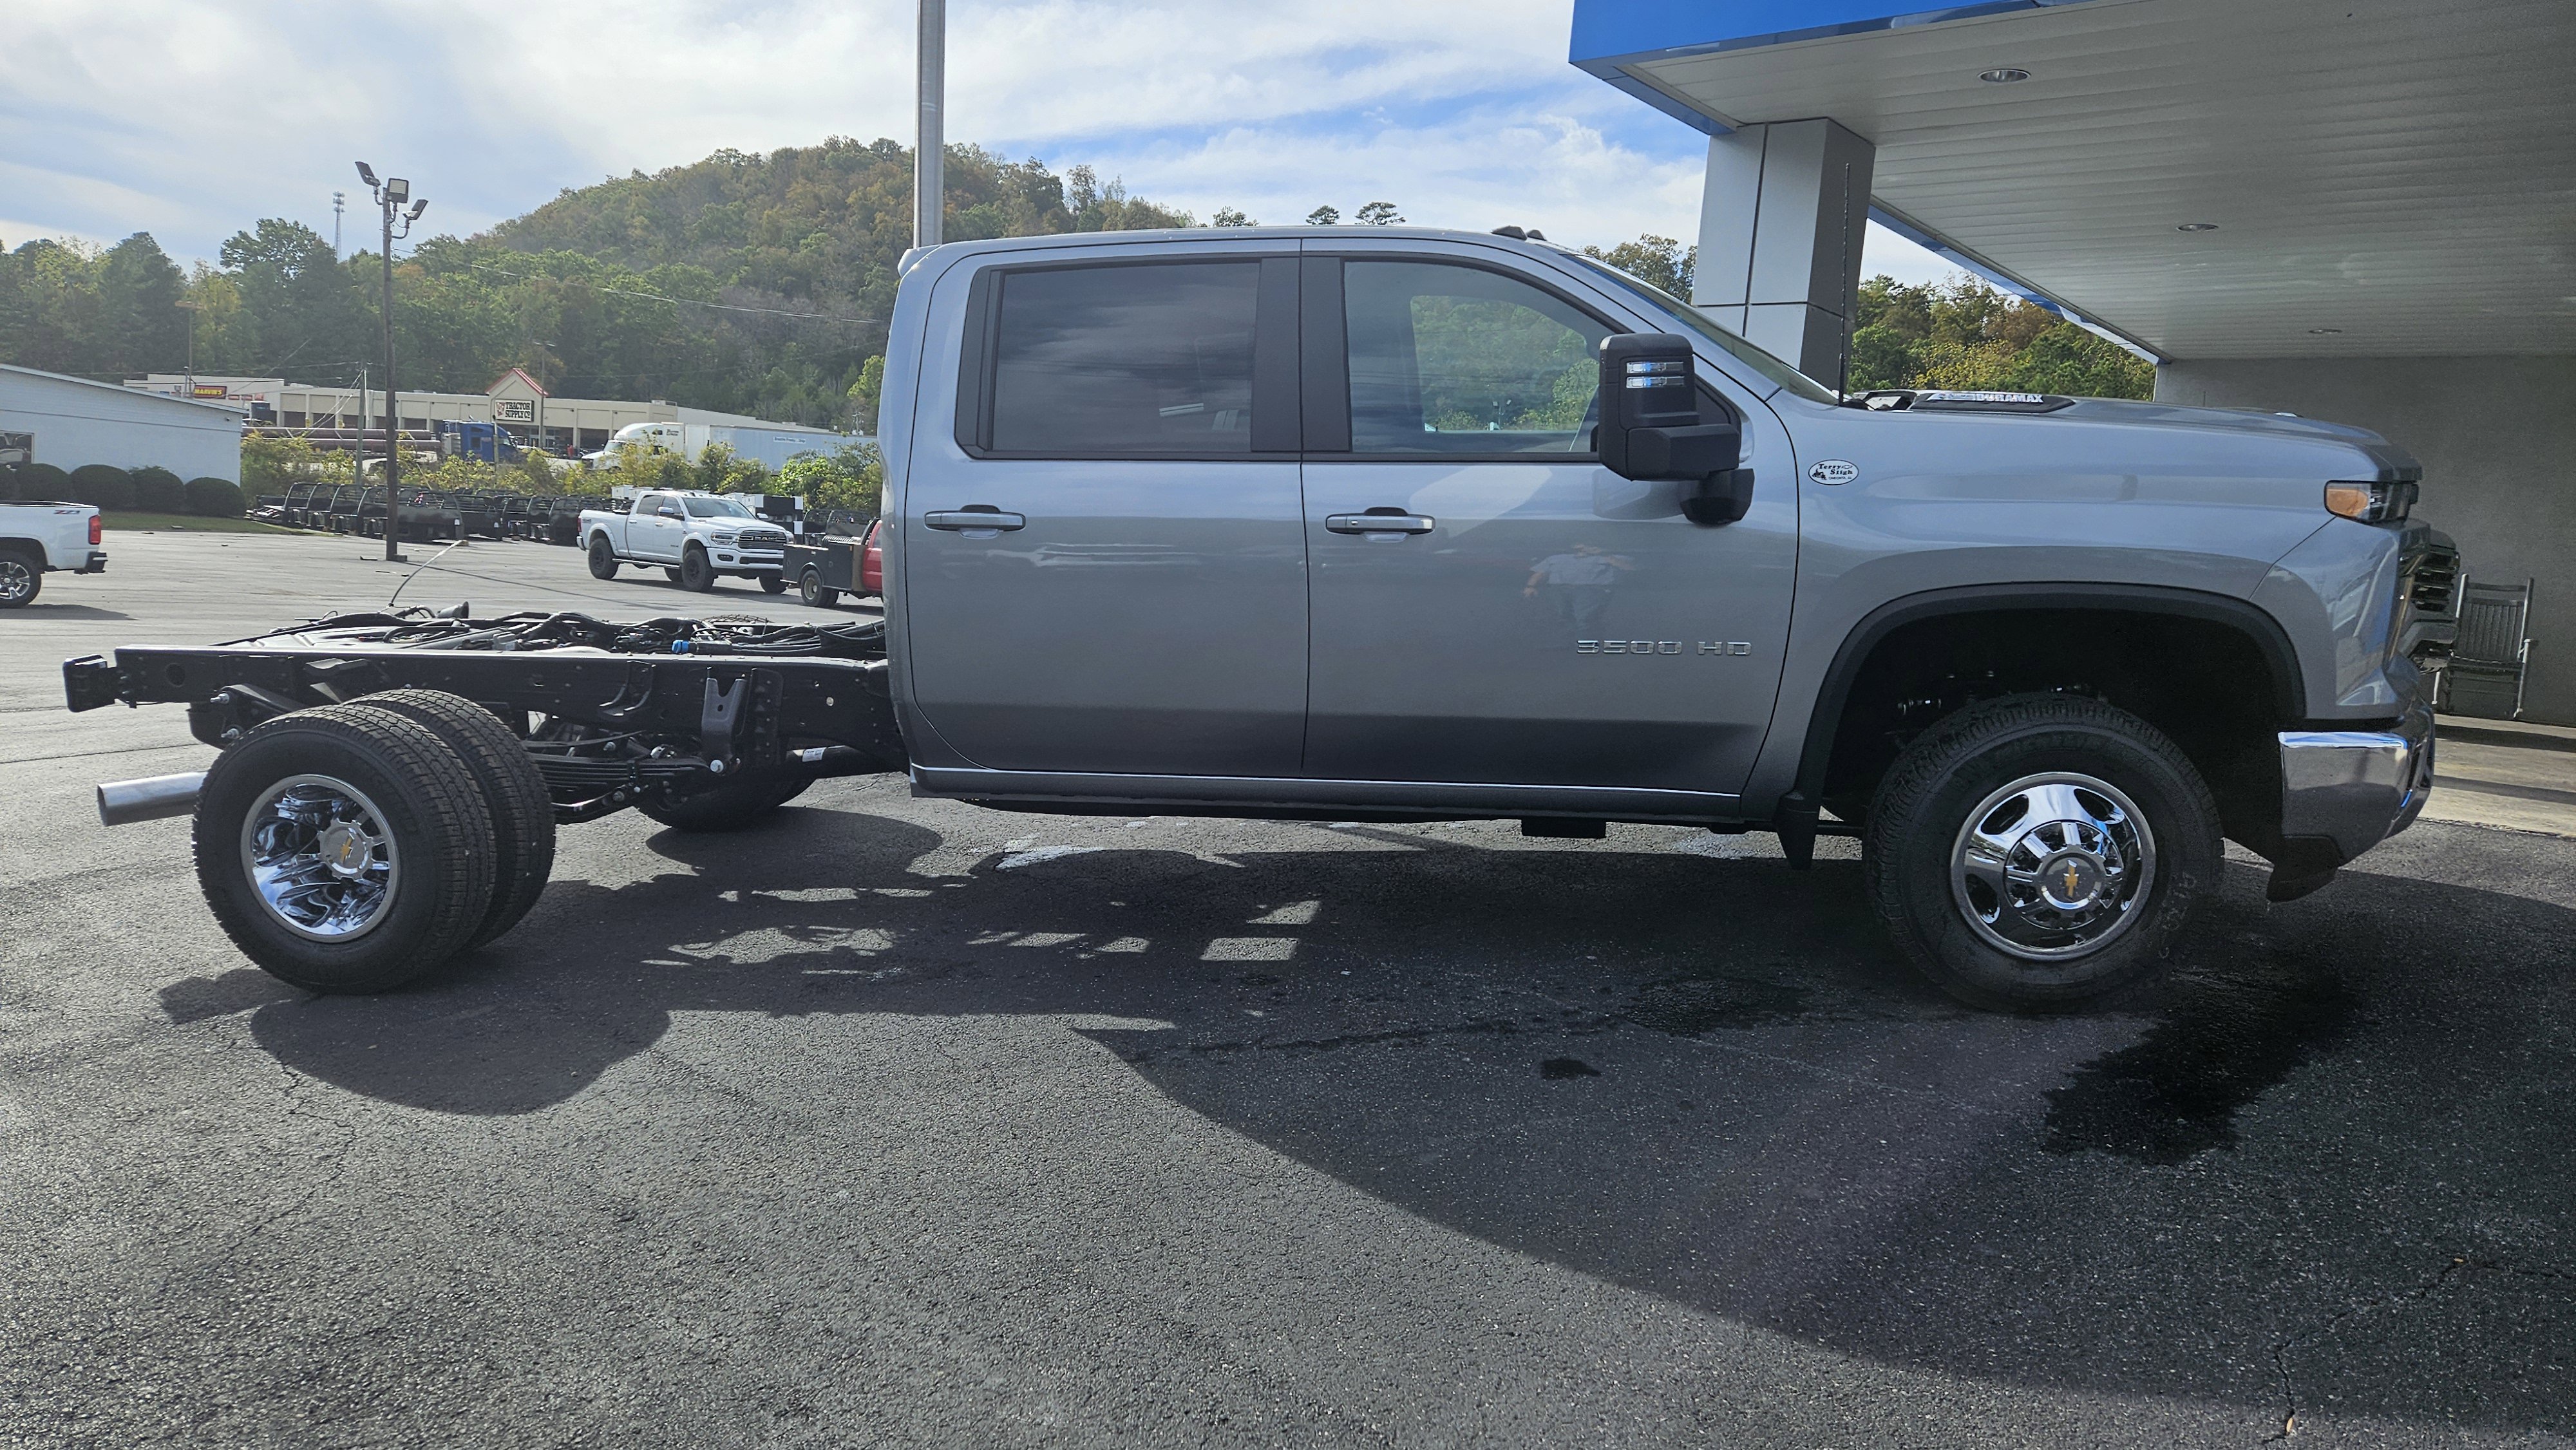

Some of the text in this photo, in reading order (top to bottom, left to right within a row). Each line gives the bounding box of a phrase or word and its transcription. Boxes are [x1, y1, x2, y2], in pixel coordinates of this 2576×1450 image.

[1976, 393, 2044, 403] DURAMAX
[506, 402, 531, 410] TRACTOR
[505, 410, 524, 419] SUPPLY
[1577, 639, 1752, 655] 3500 HD
